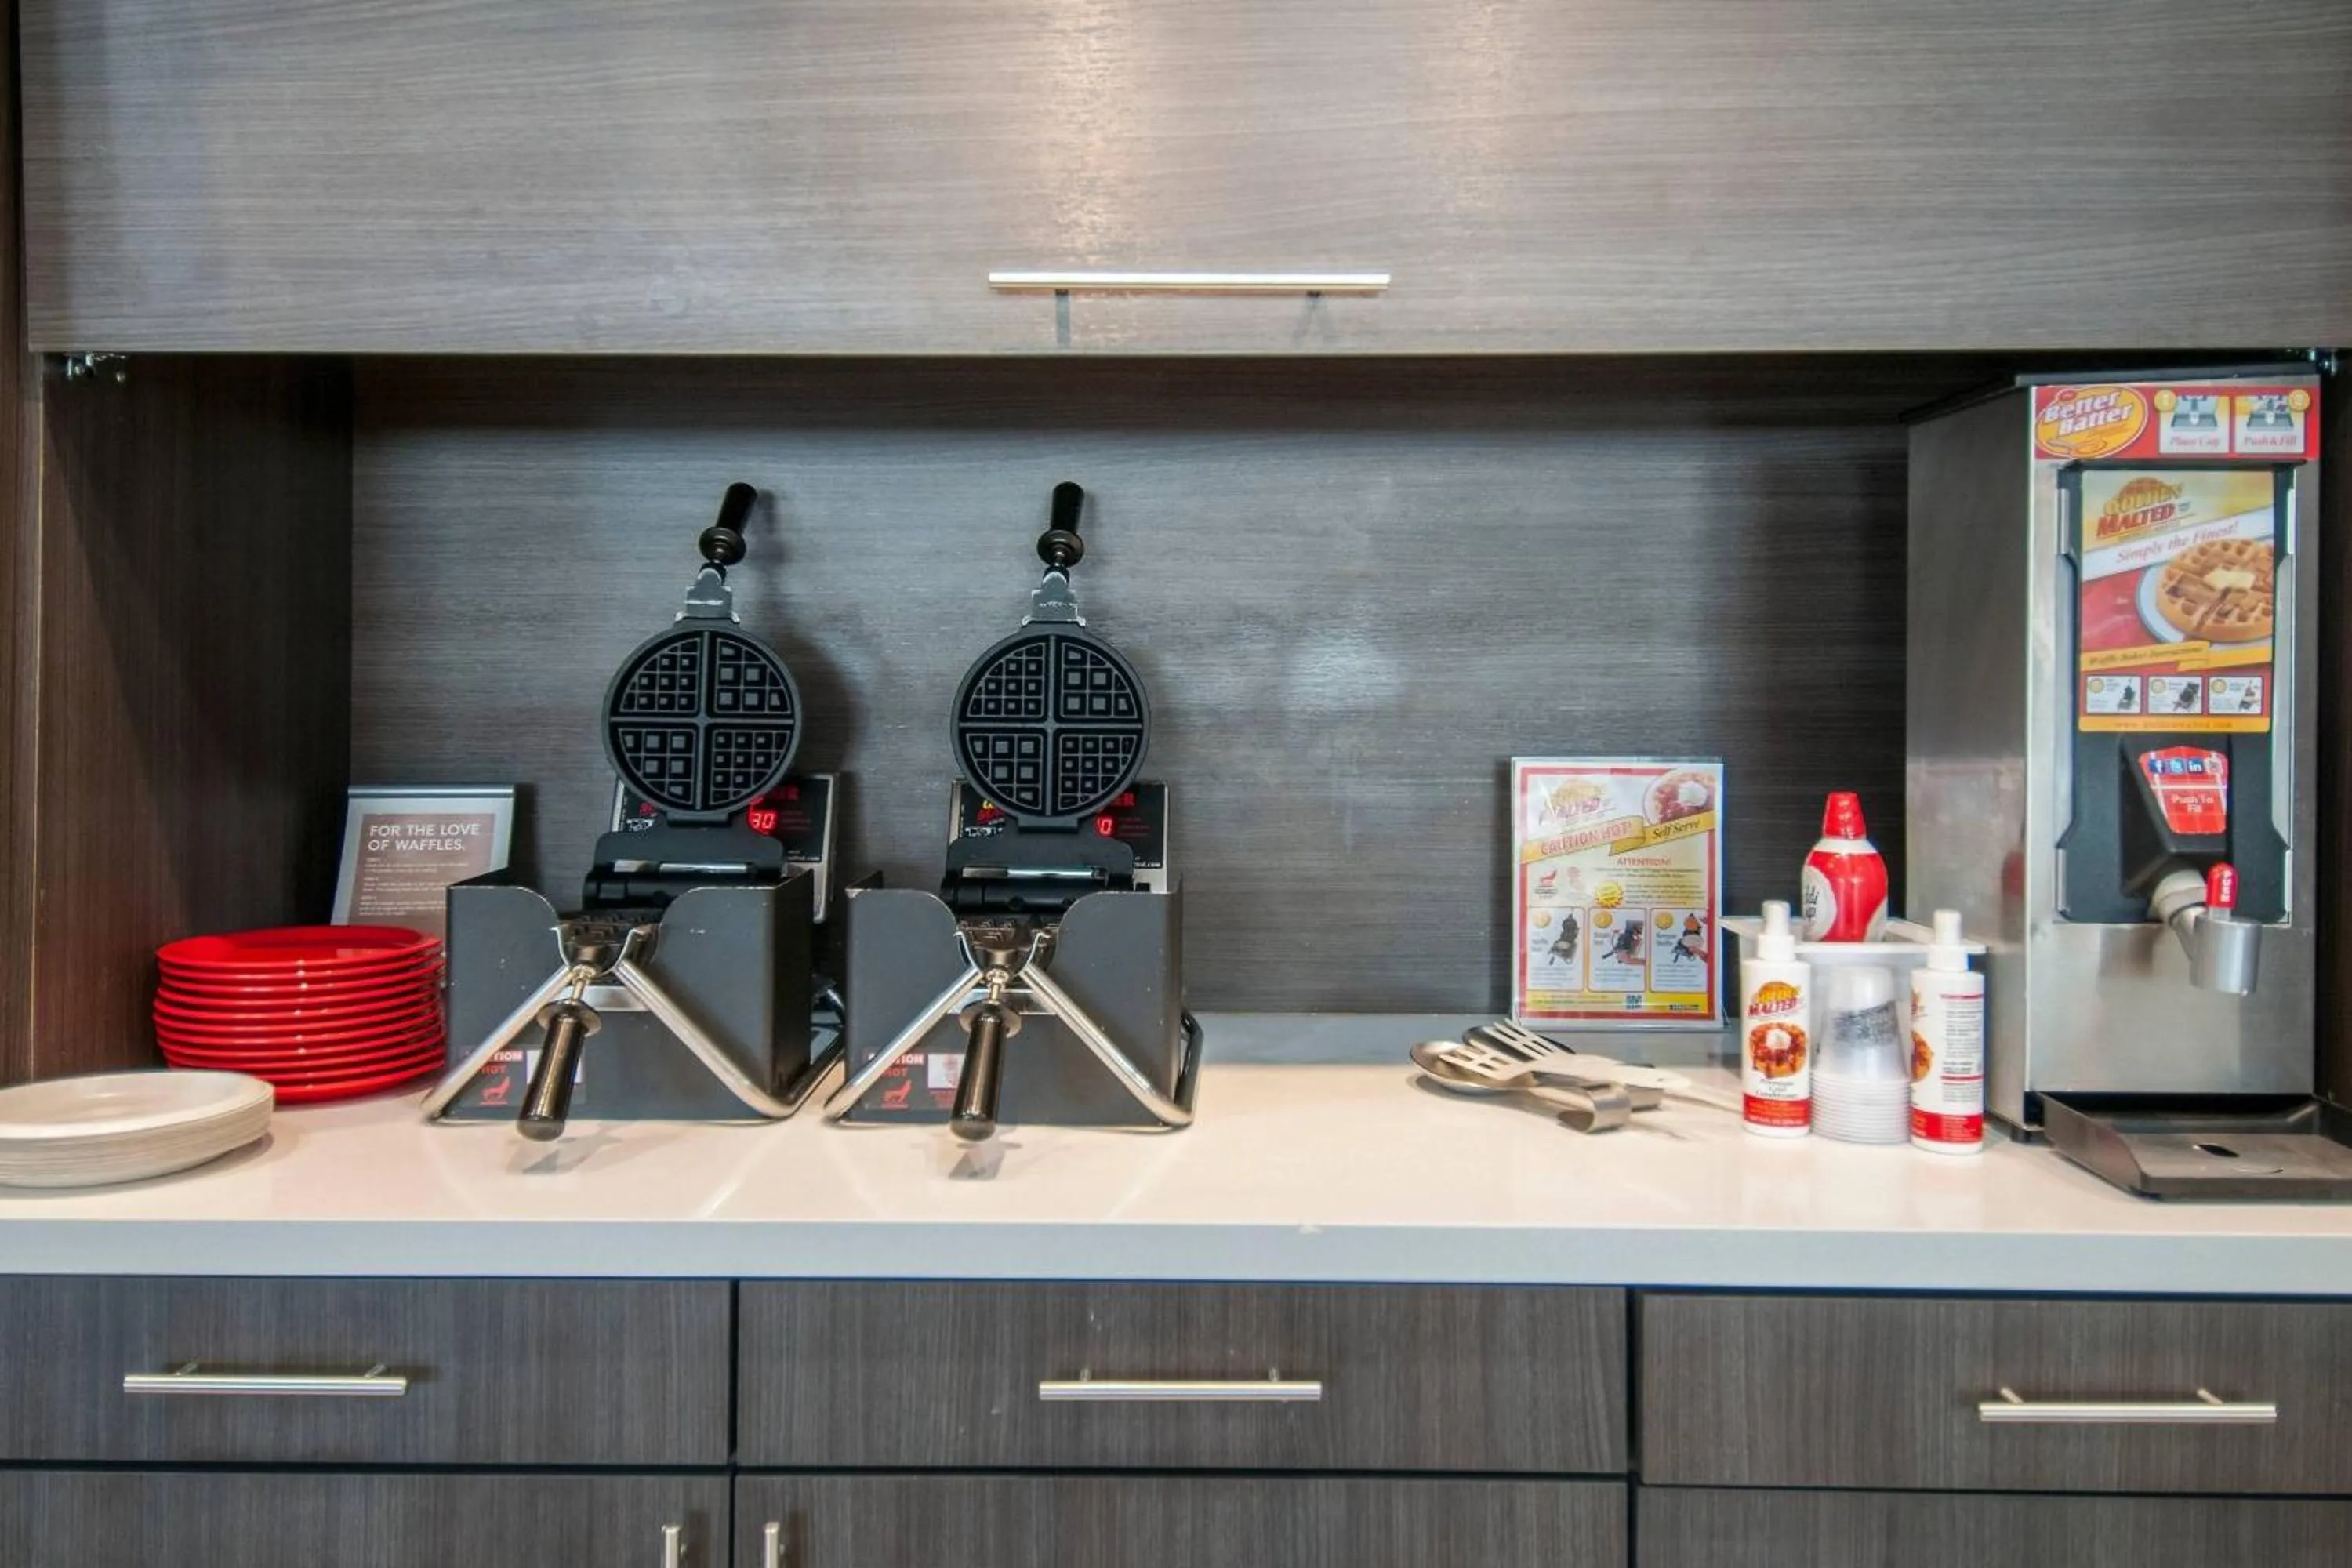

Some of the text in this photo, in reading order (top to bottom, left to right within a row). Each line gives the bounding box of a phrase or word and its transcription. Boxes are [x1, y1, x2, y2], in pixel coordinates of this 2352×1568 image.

[2117, 541, 2164, 563] Simply
[2168, 535, 2189, 550] the
[369, 822, 481, 837] FOR THE LOVE
[750, 812, 775, 829] 30
[1652, 819, 1700, 840] Self Serve
[368, 838, 466, 851] OF WAFFLES.
[1541, 821, 1632, 855] CAUTION HOT!
